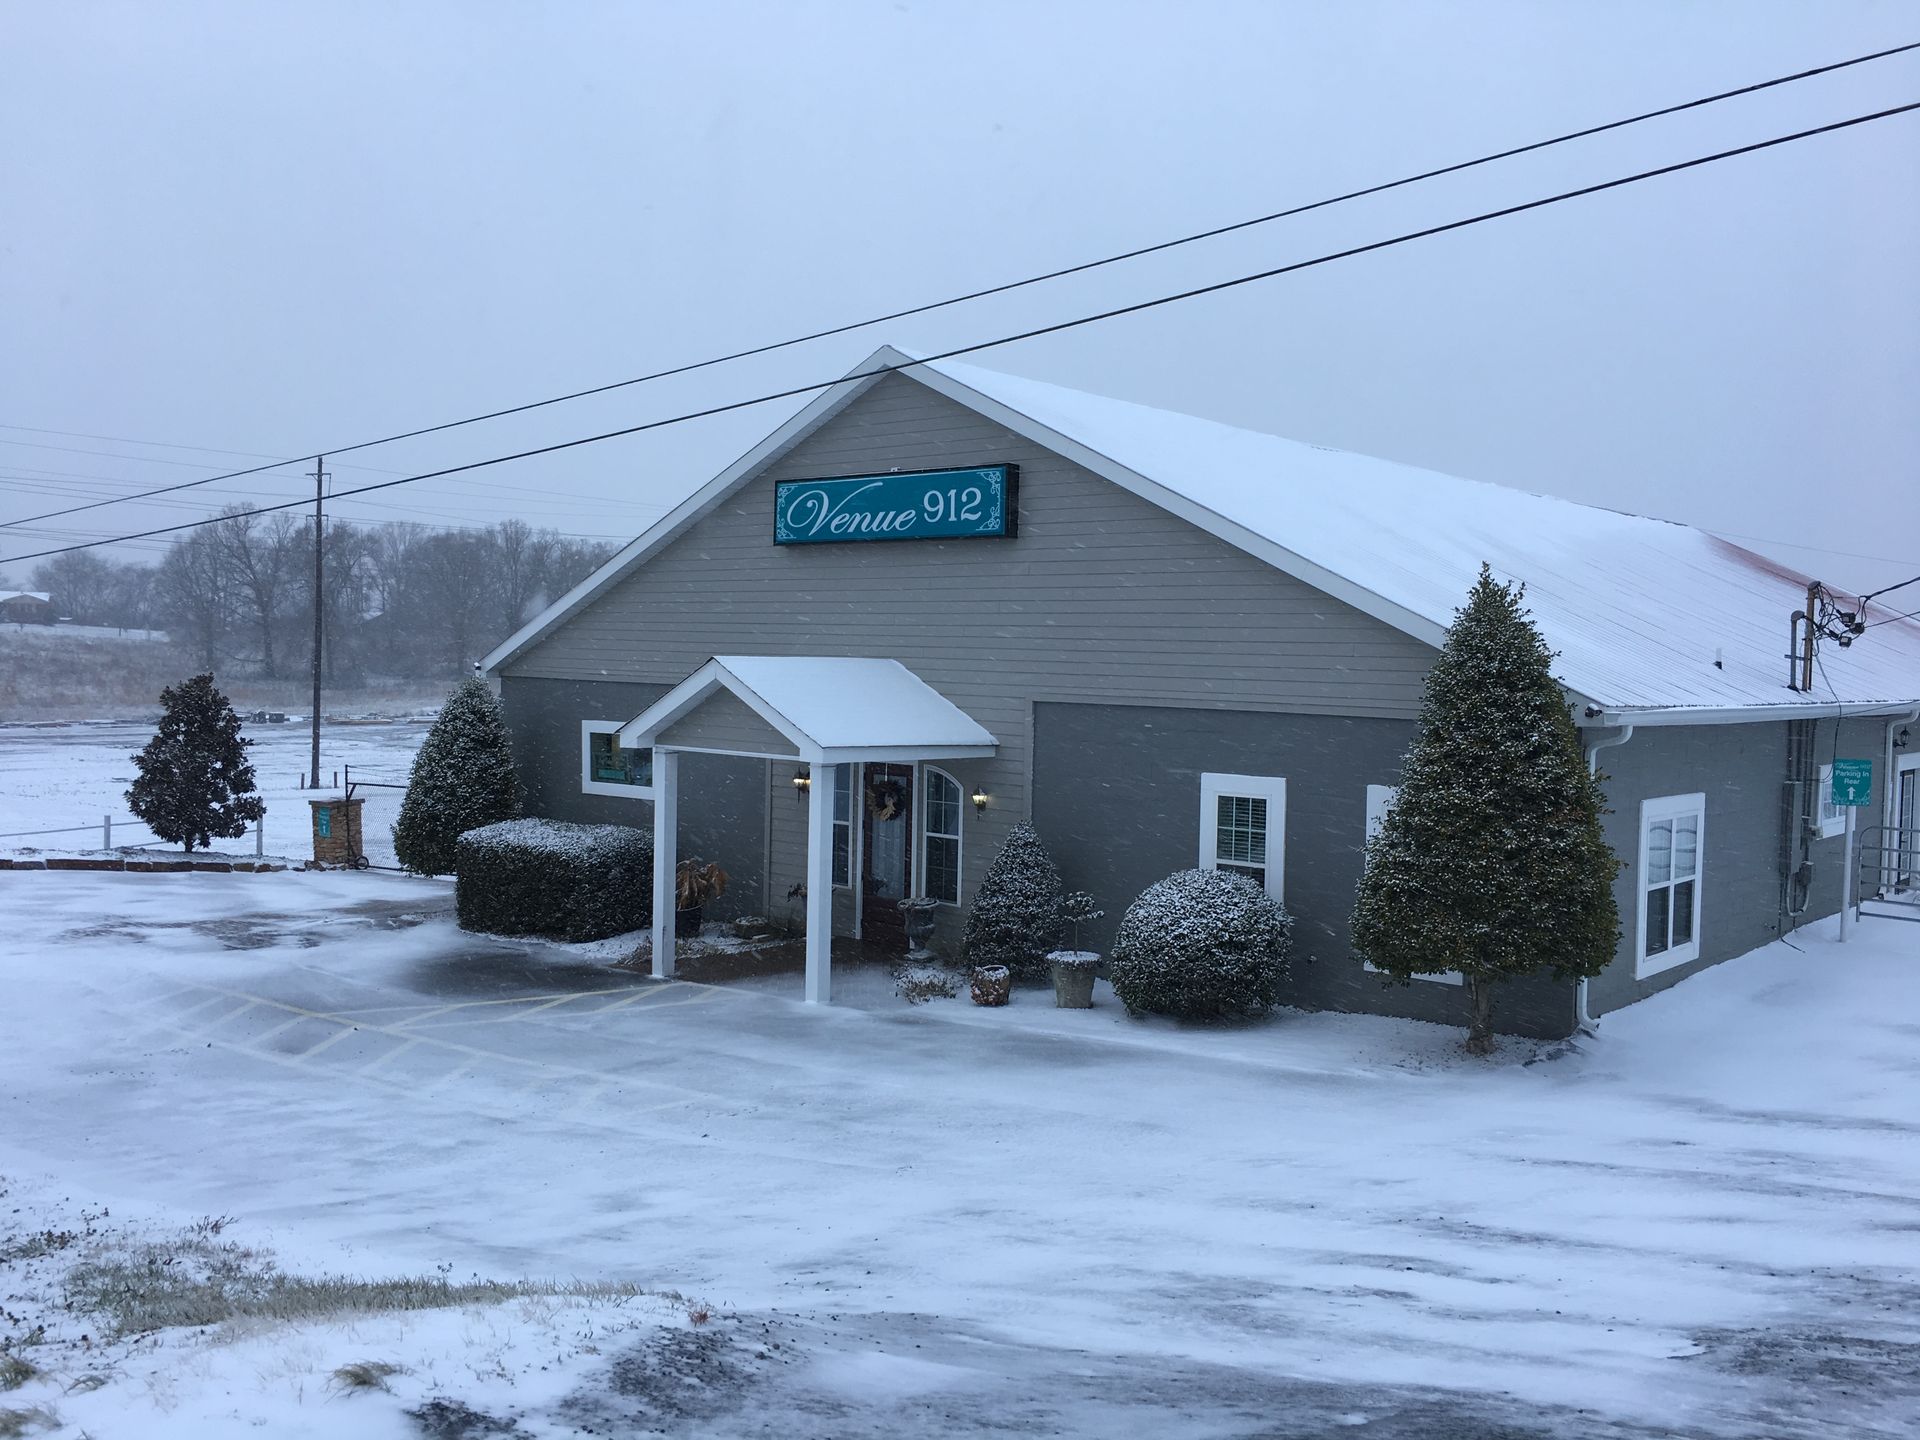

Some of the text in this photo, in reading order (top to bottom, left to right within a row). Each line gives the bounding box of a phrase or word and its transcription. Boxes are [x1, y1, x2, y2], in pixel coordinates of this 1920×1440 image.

[786, 481, 982, 537] Venue 912
[1835, 769, 1861, 779] Parking
[1843, 777, 1860, 785] Rear
